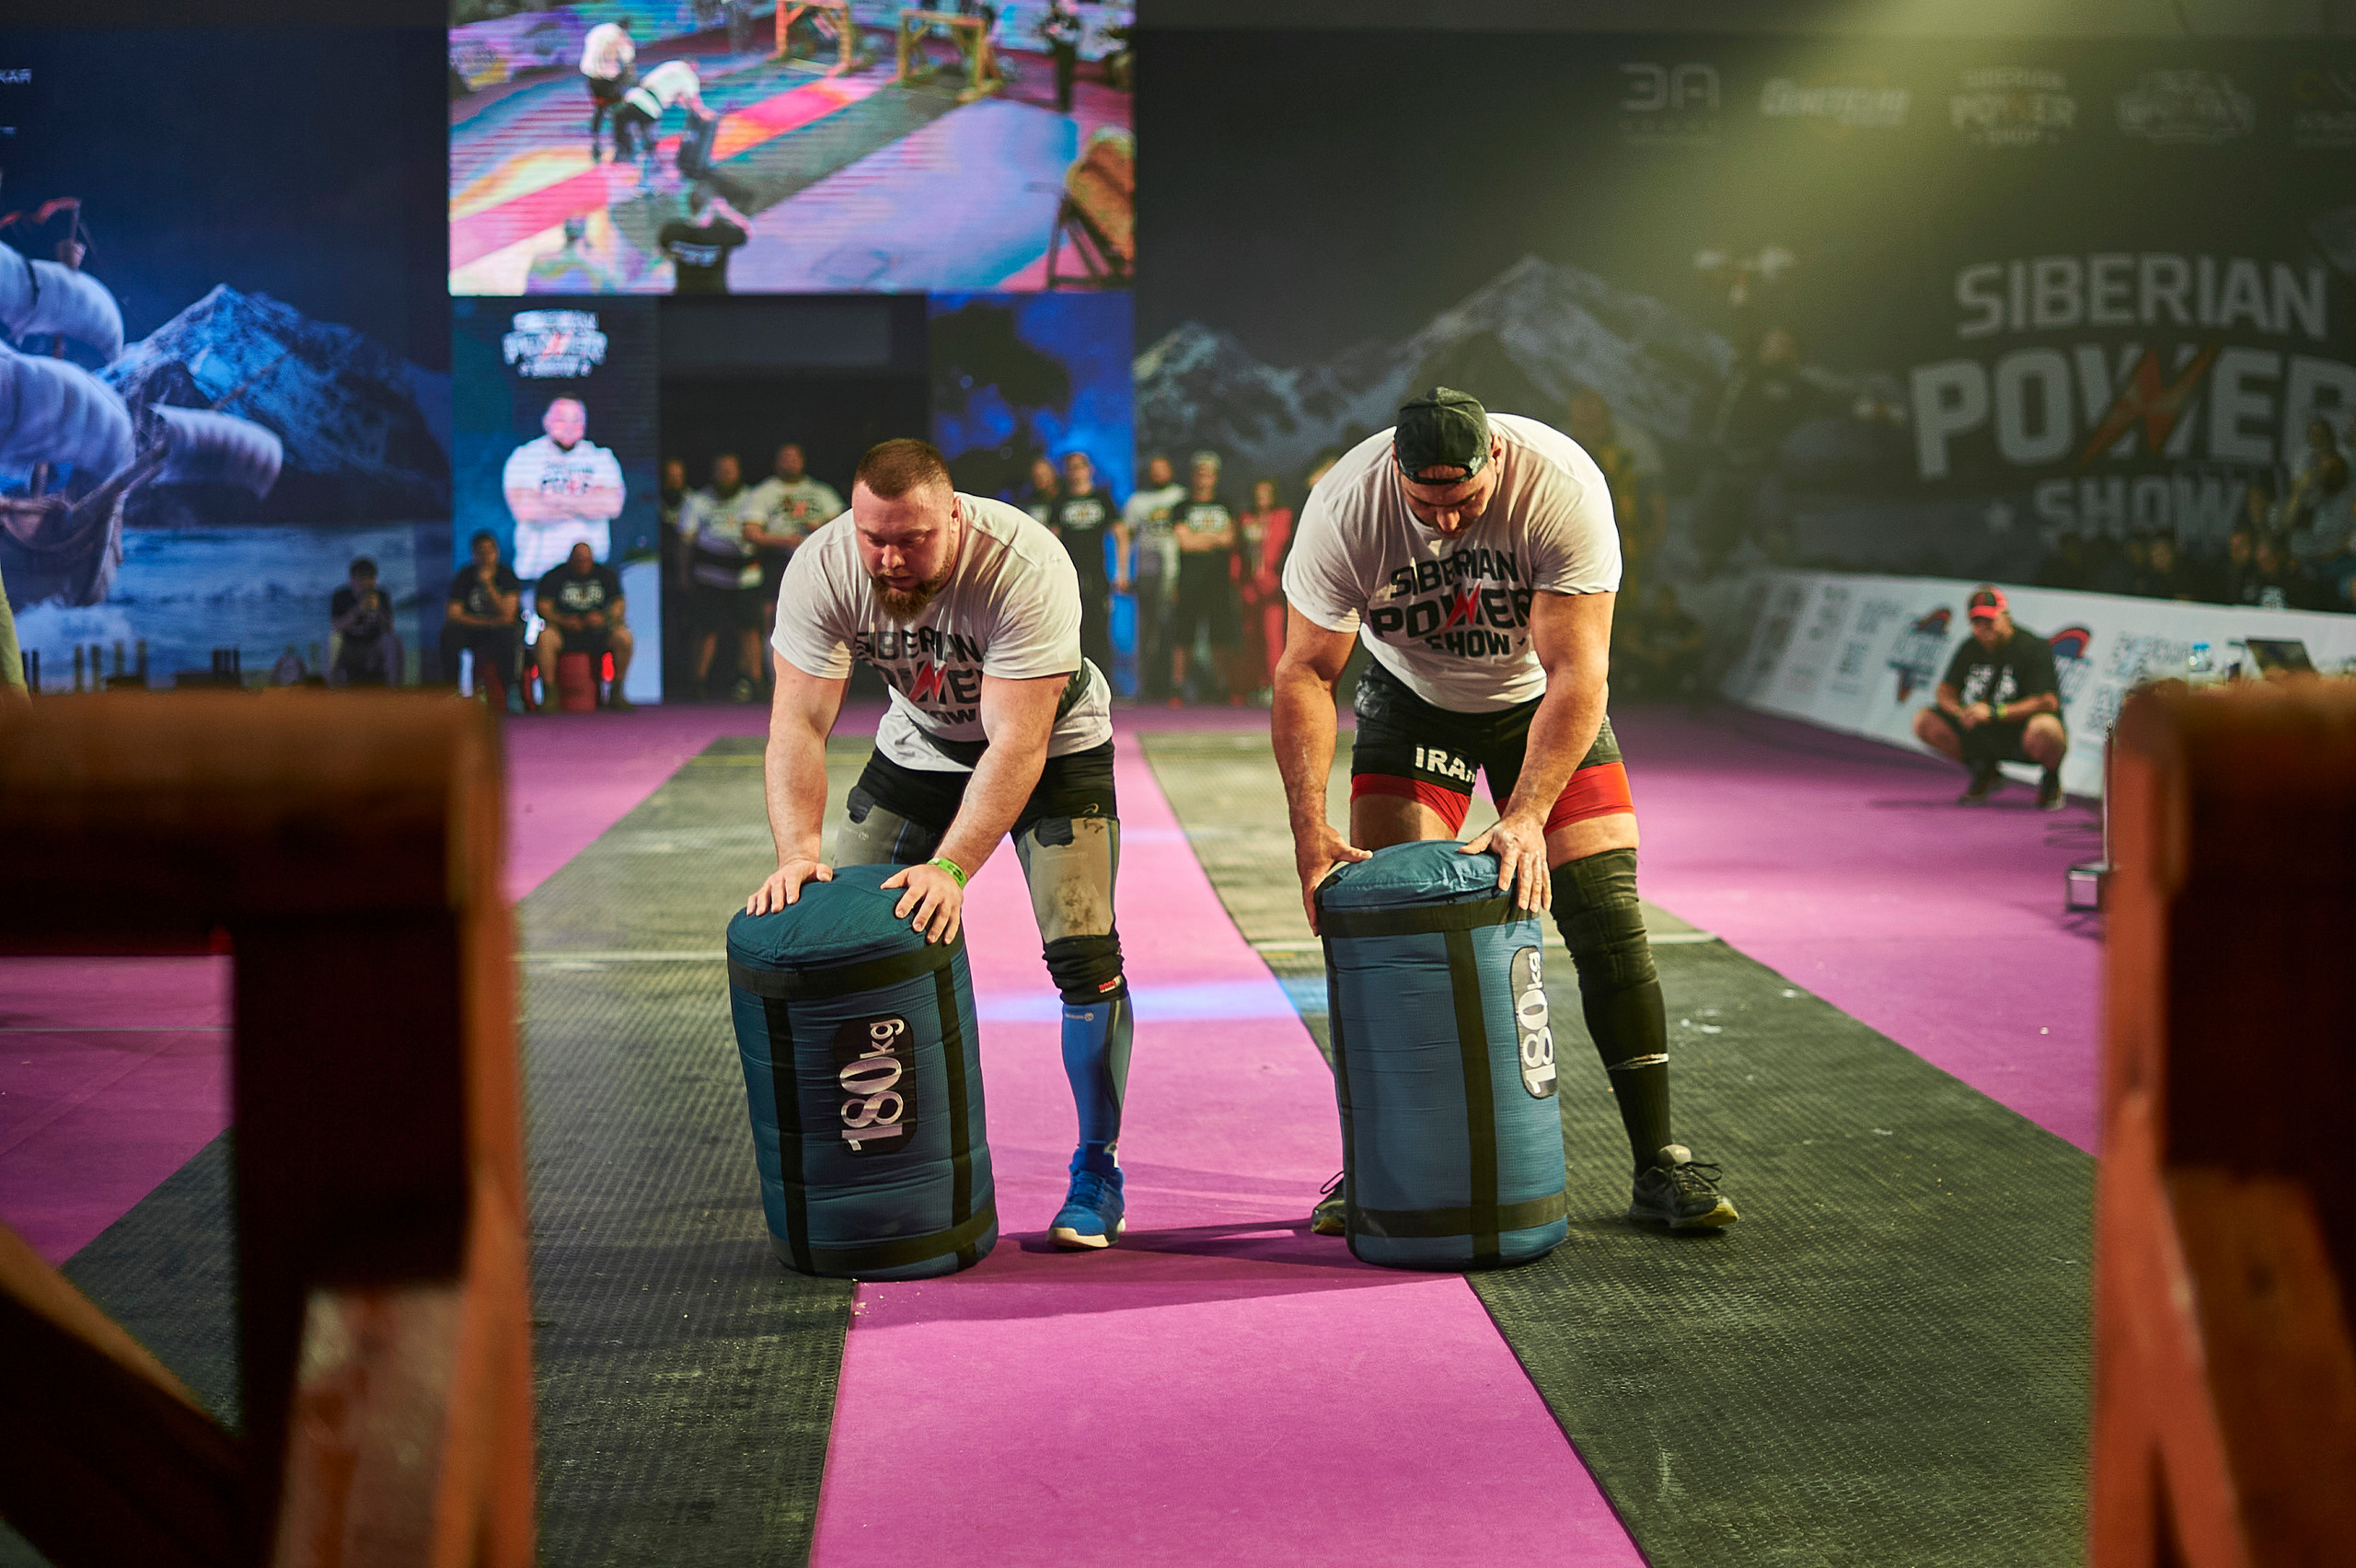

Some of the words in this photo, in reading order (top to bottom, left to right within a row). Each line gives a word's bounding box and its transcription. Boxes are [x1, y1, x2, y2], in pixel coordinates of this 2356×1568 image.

[1956, 253, 2327, 340] SIBERIAN
[2034, 474, 2247, 554] SHOW
[1391, 548, 1519, 598] SIBERIAN
[1426, 629, 1510, 657] SHOW
